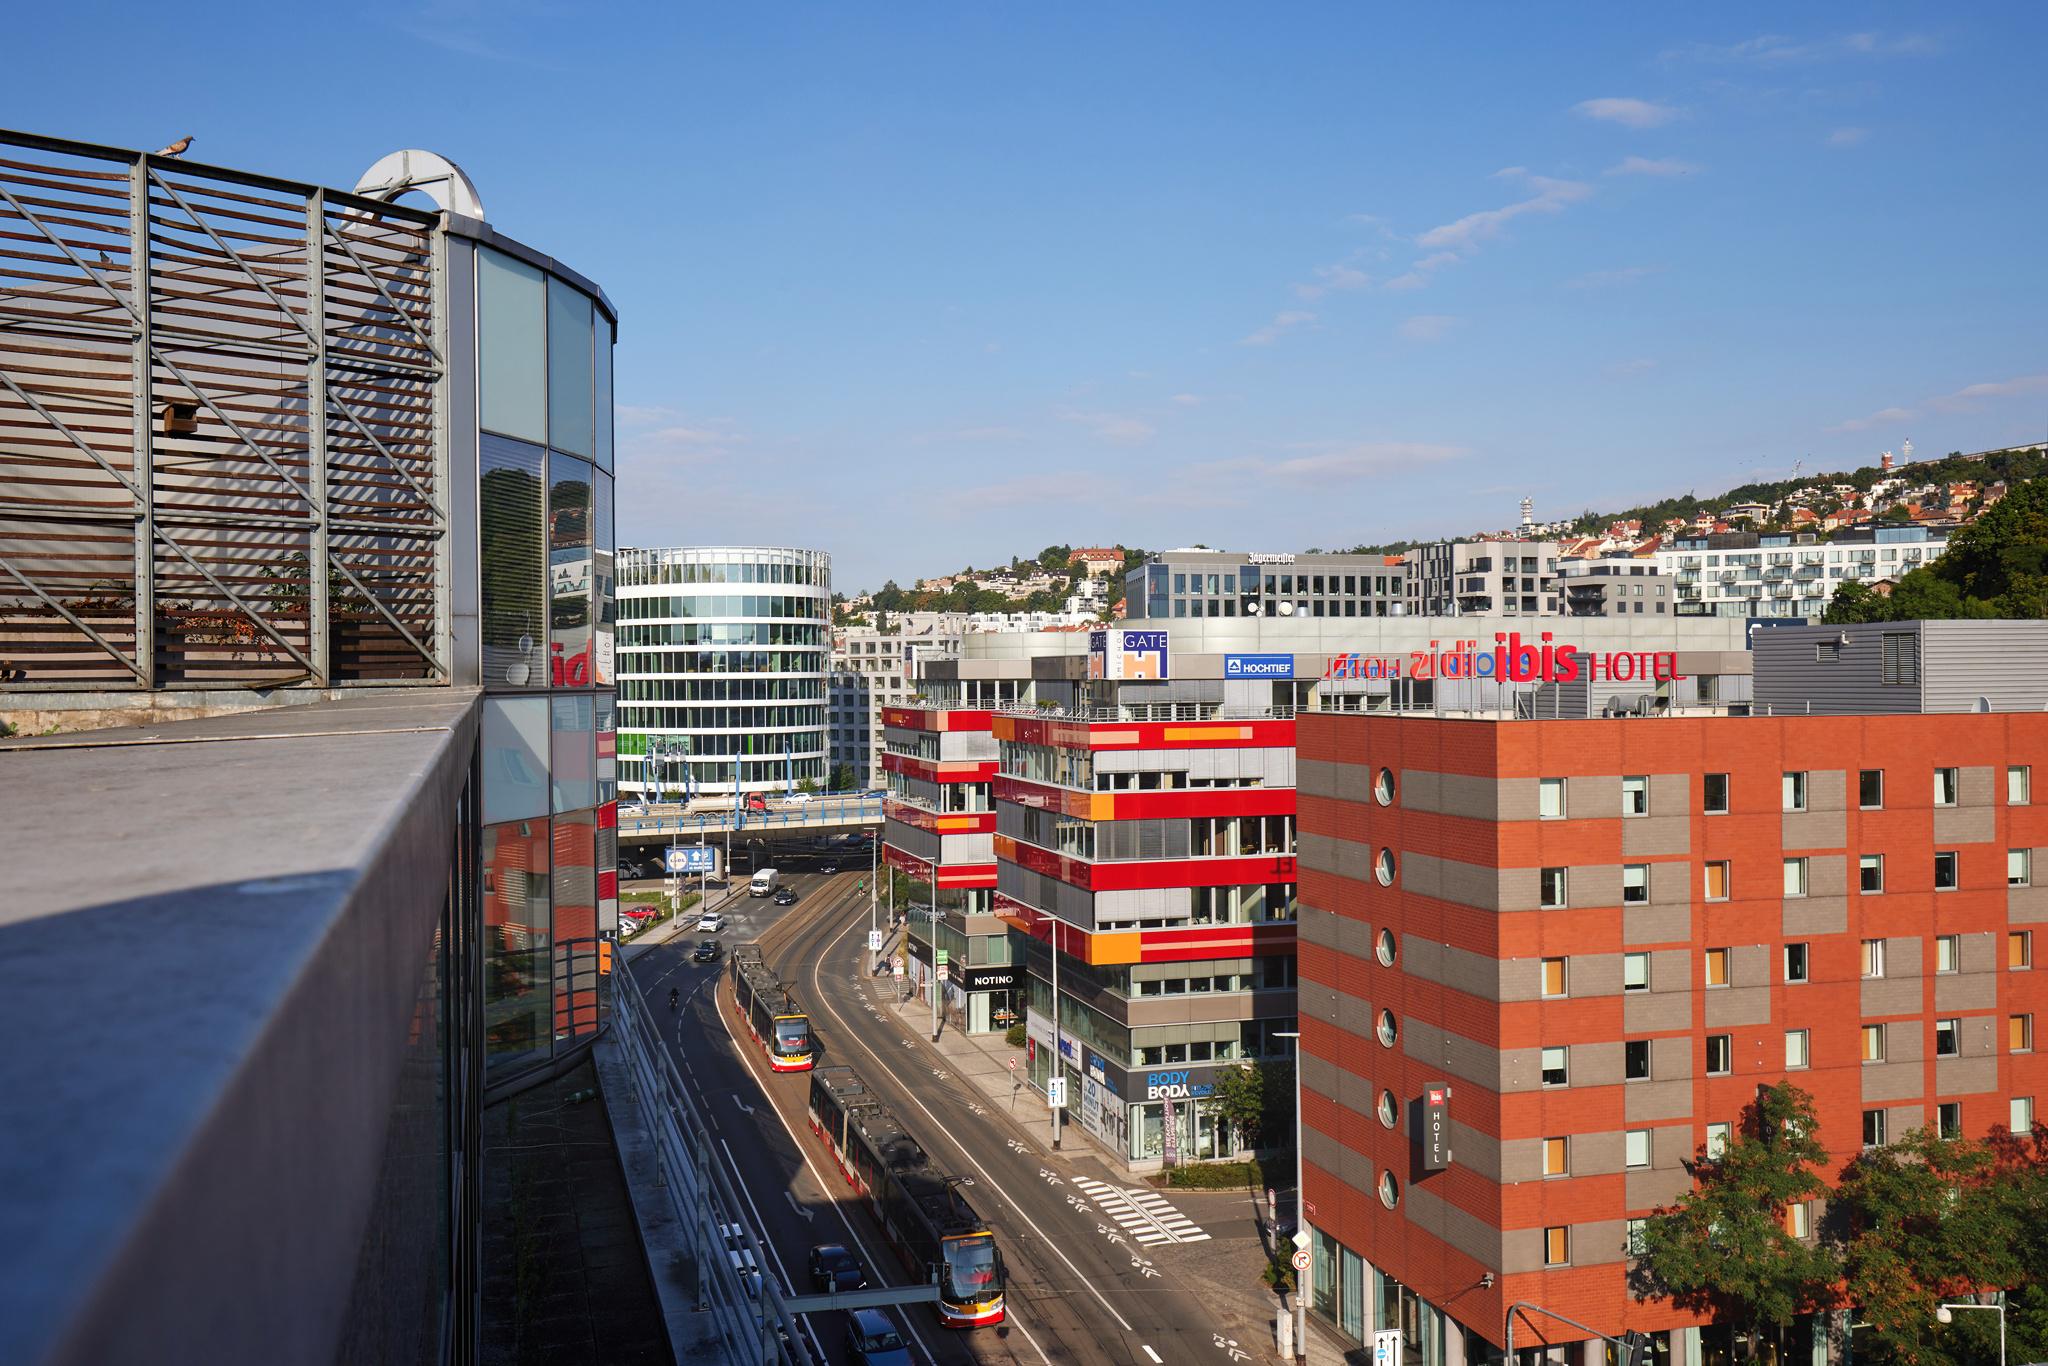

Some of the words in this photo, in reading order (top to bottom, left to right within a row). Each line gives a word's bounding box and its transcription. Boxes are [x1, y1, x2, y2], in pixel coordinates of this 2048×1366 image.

[1124, 634, 1167, 648] GATE
[1494, 631, 1579, 683] ibis
[1591, 651, 1687, 682] HOTEL
[1243, 663, 1291, 673] HOCHTIEF
[974, 975, 1014, 986] NOTINO
[1147, 1071, 1190, 1087] BODY
[1087, 1080, 1096, 1098] 20
